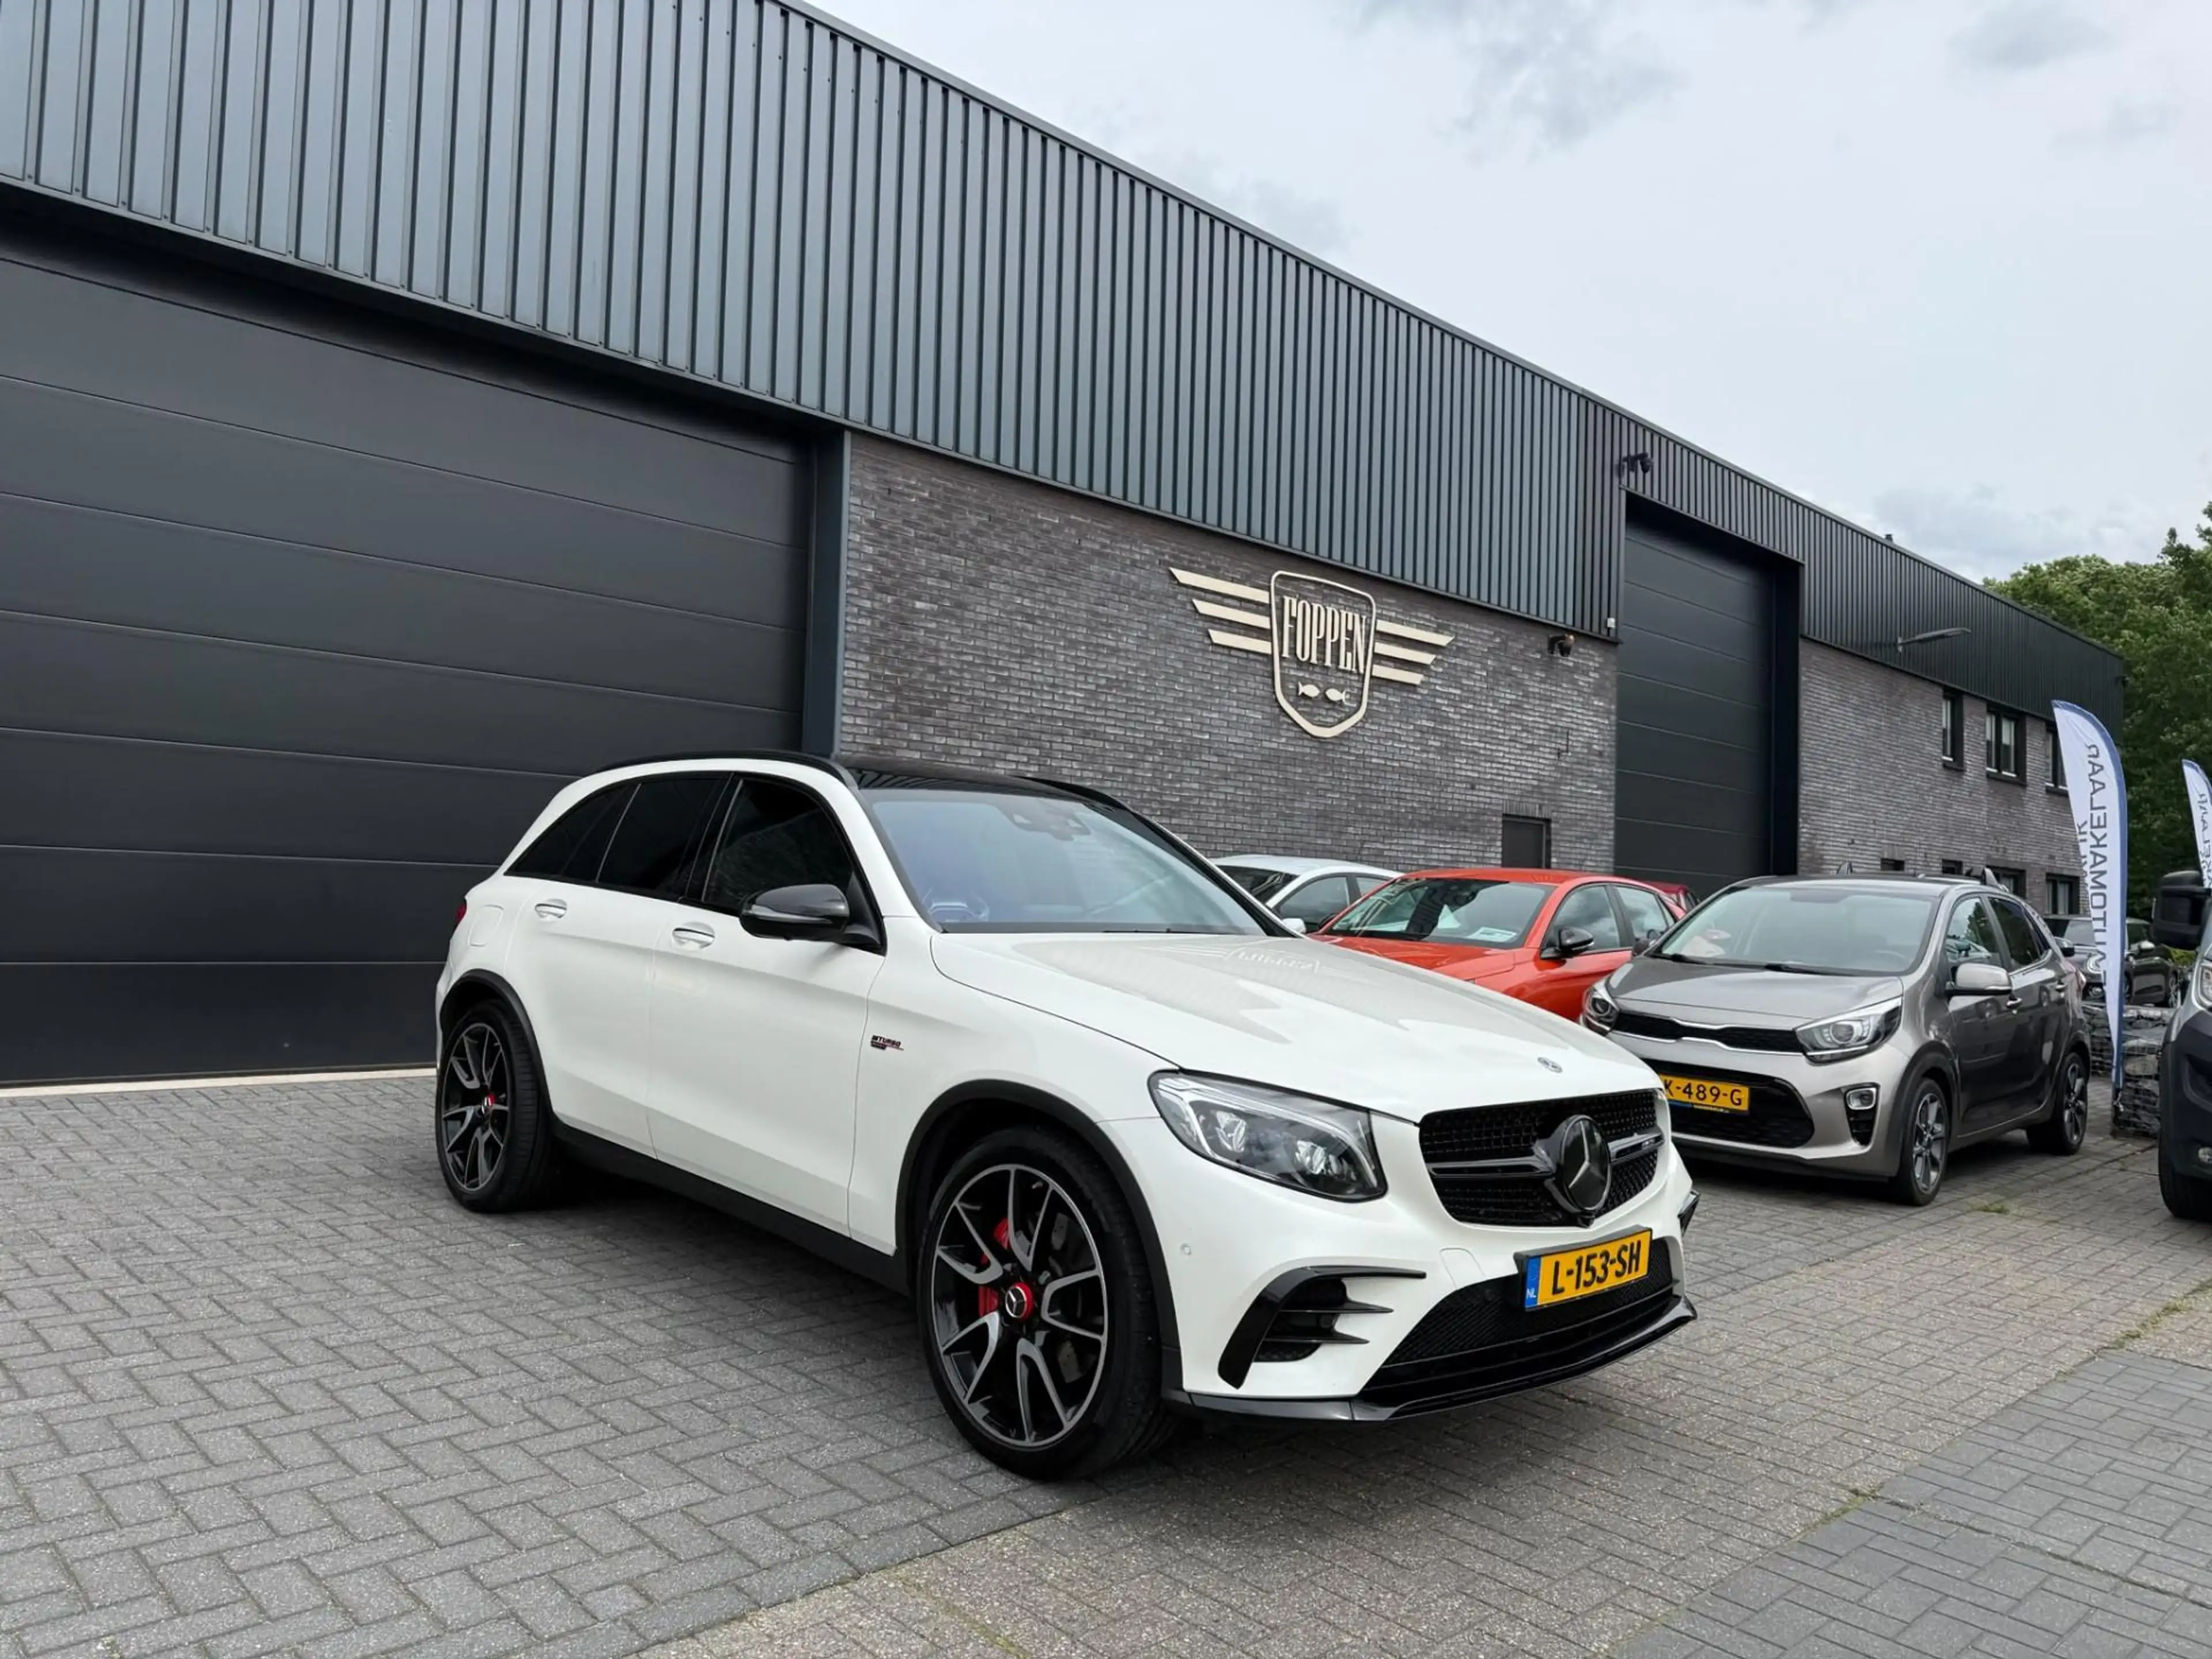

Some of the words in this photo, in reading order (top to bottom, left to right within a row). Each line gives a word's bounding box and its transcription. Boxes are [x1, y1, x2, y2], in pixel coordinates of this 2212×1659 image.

[1281, 595, 1366, 674] FOPPEN
[1526, 1287, 1537, 1300] NL
[1552, 1240, 1642, 1295] L-153-SH
